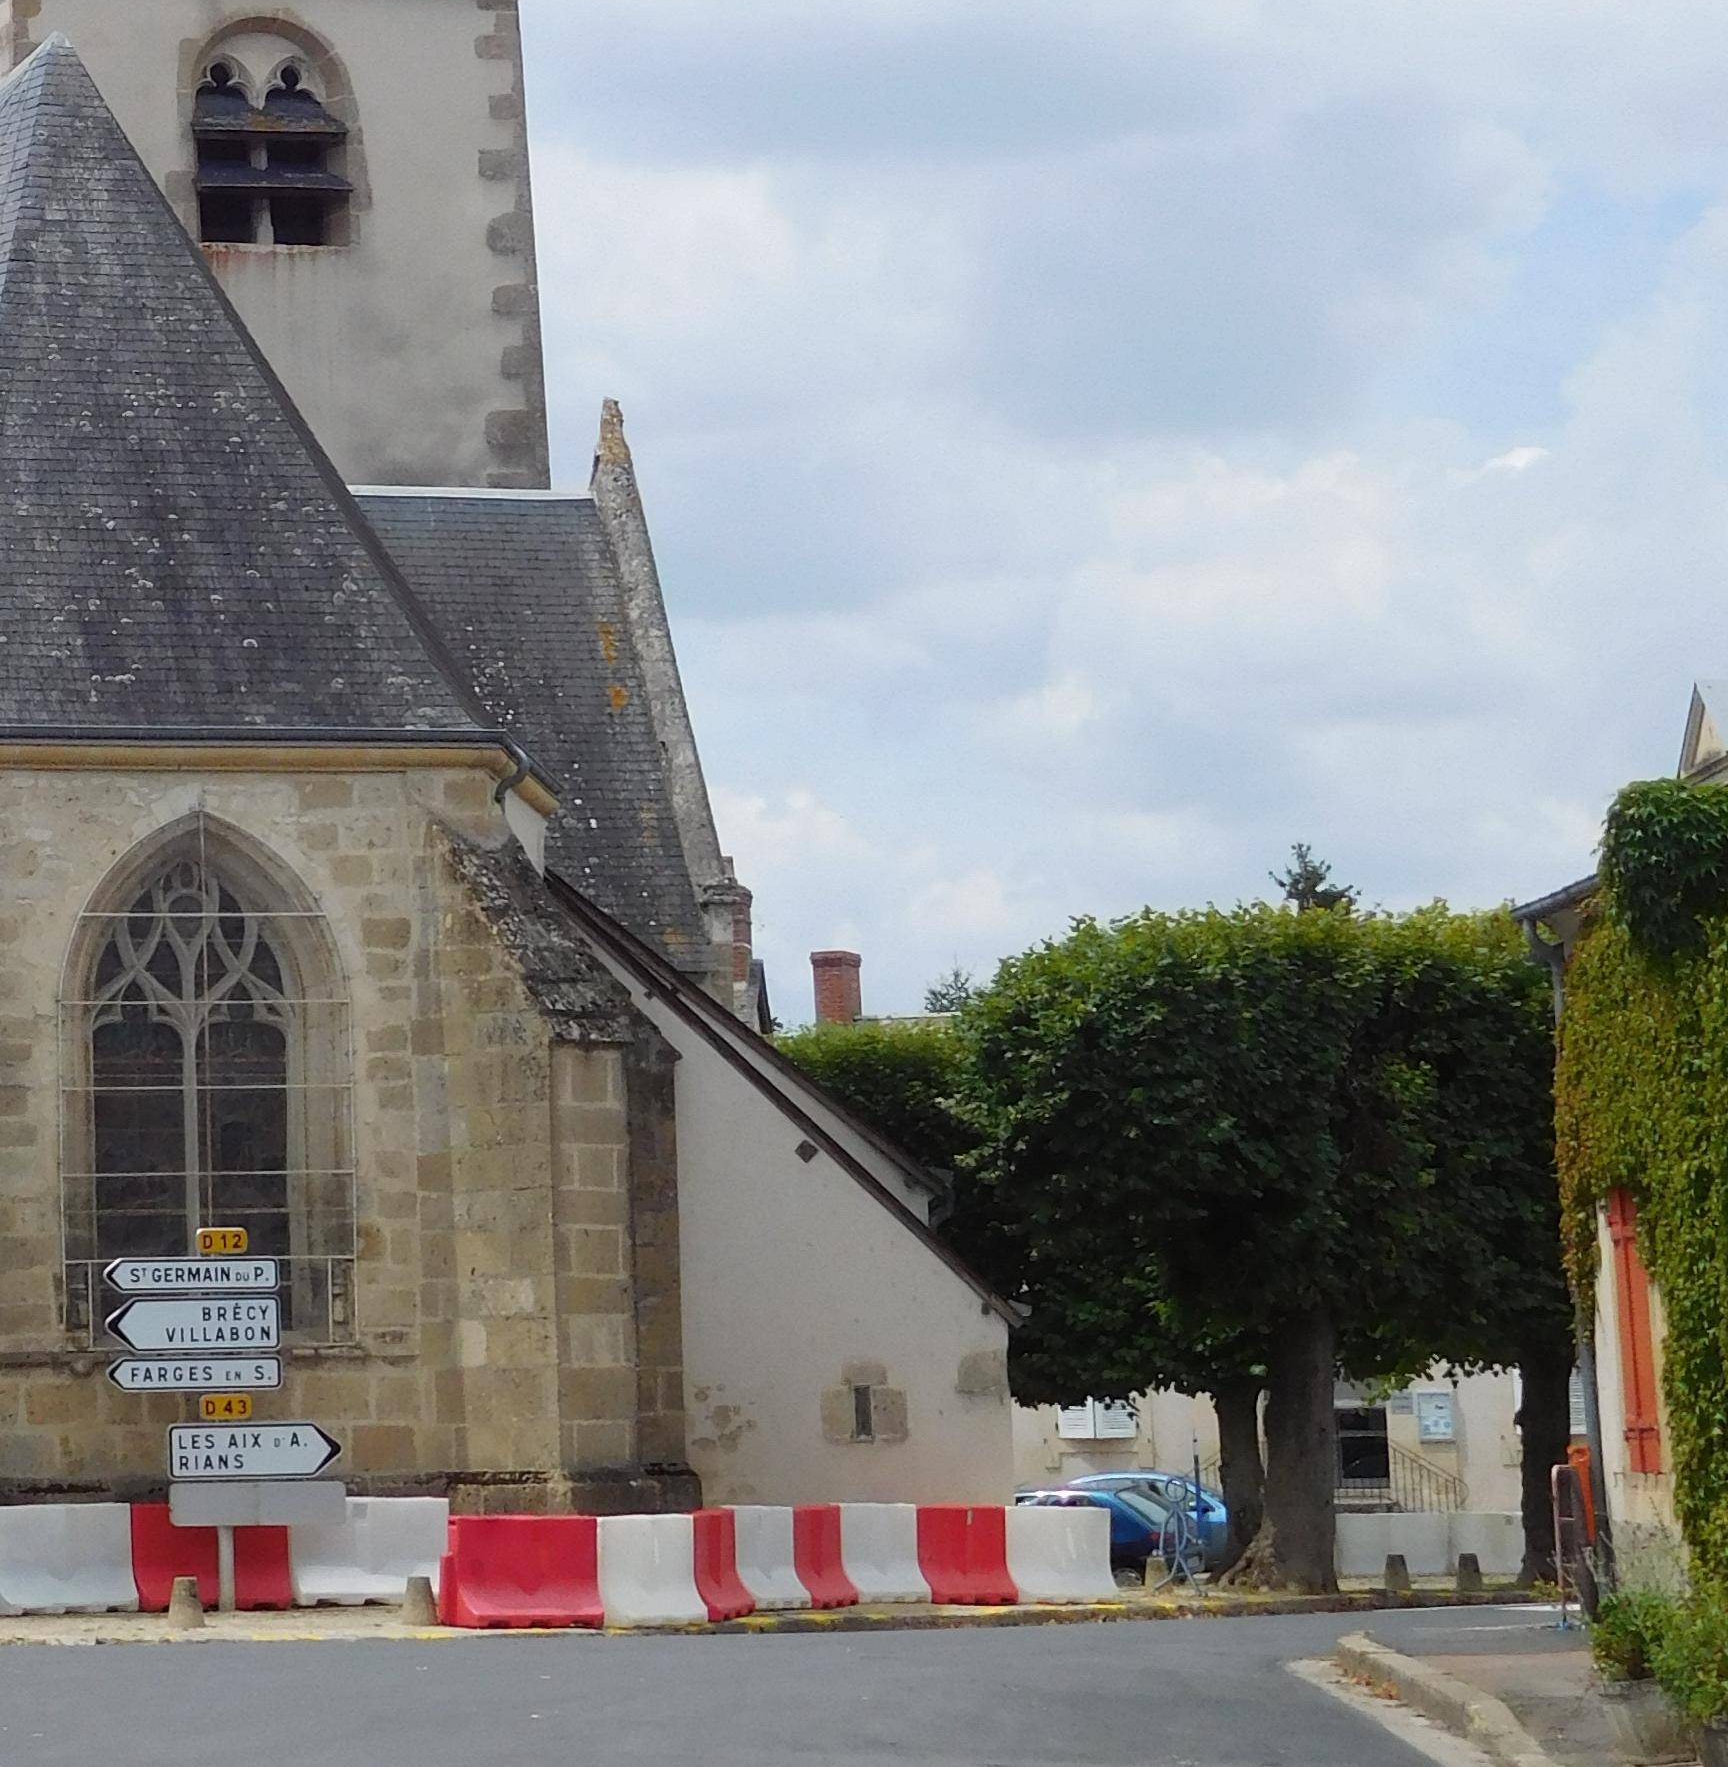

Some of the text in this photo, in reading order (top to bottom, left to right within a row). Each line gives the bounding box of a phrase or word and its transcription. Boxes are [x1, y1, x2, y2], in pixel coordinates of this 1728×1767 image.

[153, 1267, 230, 1283] GERMAIN
[254, 1267, 269, 1282] P.
[202, 1303, 269, 1322] BRÉCY
[166, 1327, 271, 1343] VILLABON
[131, 1365, 271, 1382] FARGES EN S.
[178, 1435, 215, 1450] LES
[228, 1434, 261, 1449] AIX
[179, 1454, 244, 1471] RIANS
